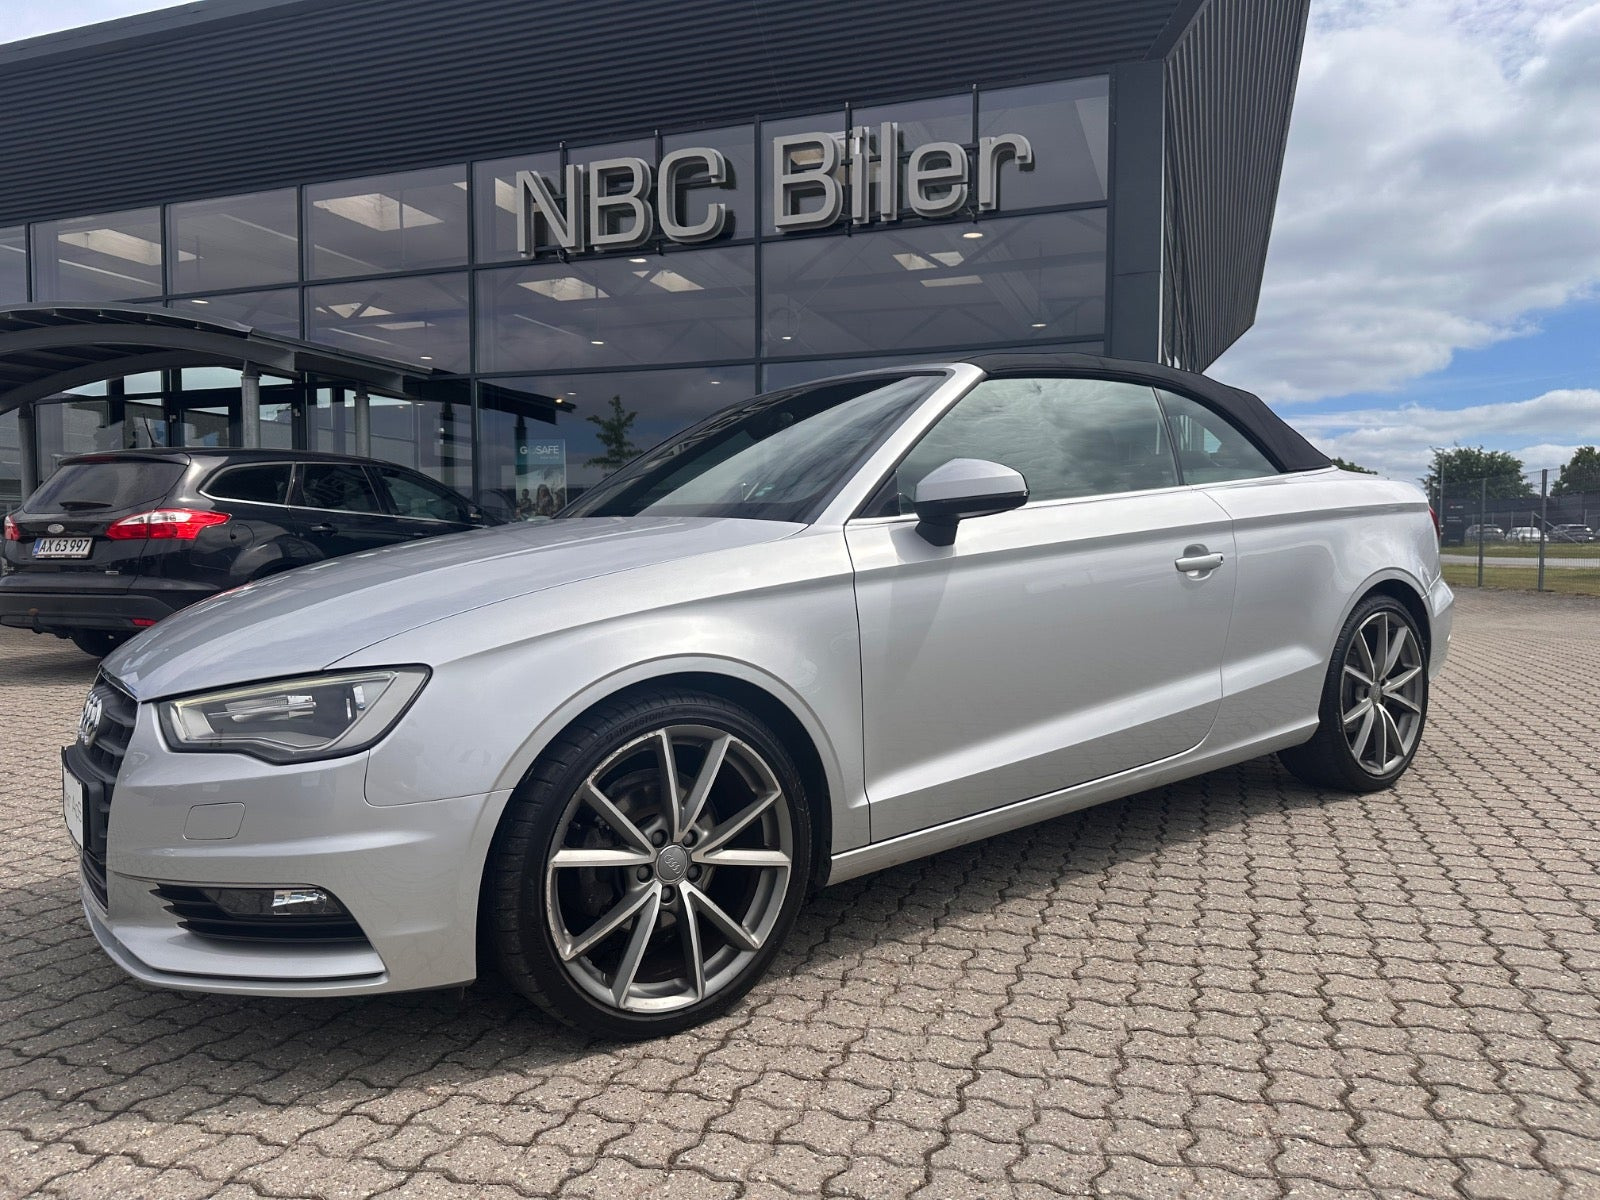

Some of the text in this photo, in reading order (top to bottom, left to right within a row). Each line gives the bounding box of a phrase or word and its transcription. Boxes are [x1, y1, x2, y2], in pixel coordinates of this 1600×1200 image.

[516, 122, 1034, 257] NBC Biler
[39, 539, 90, 552] AX 63 997
